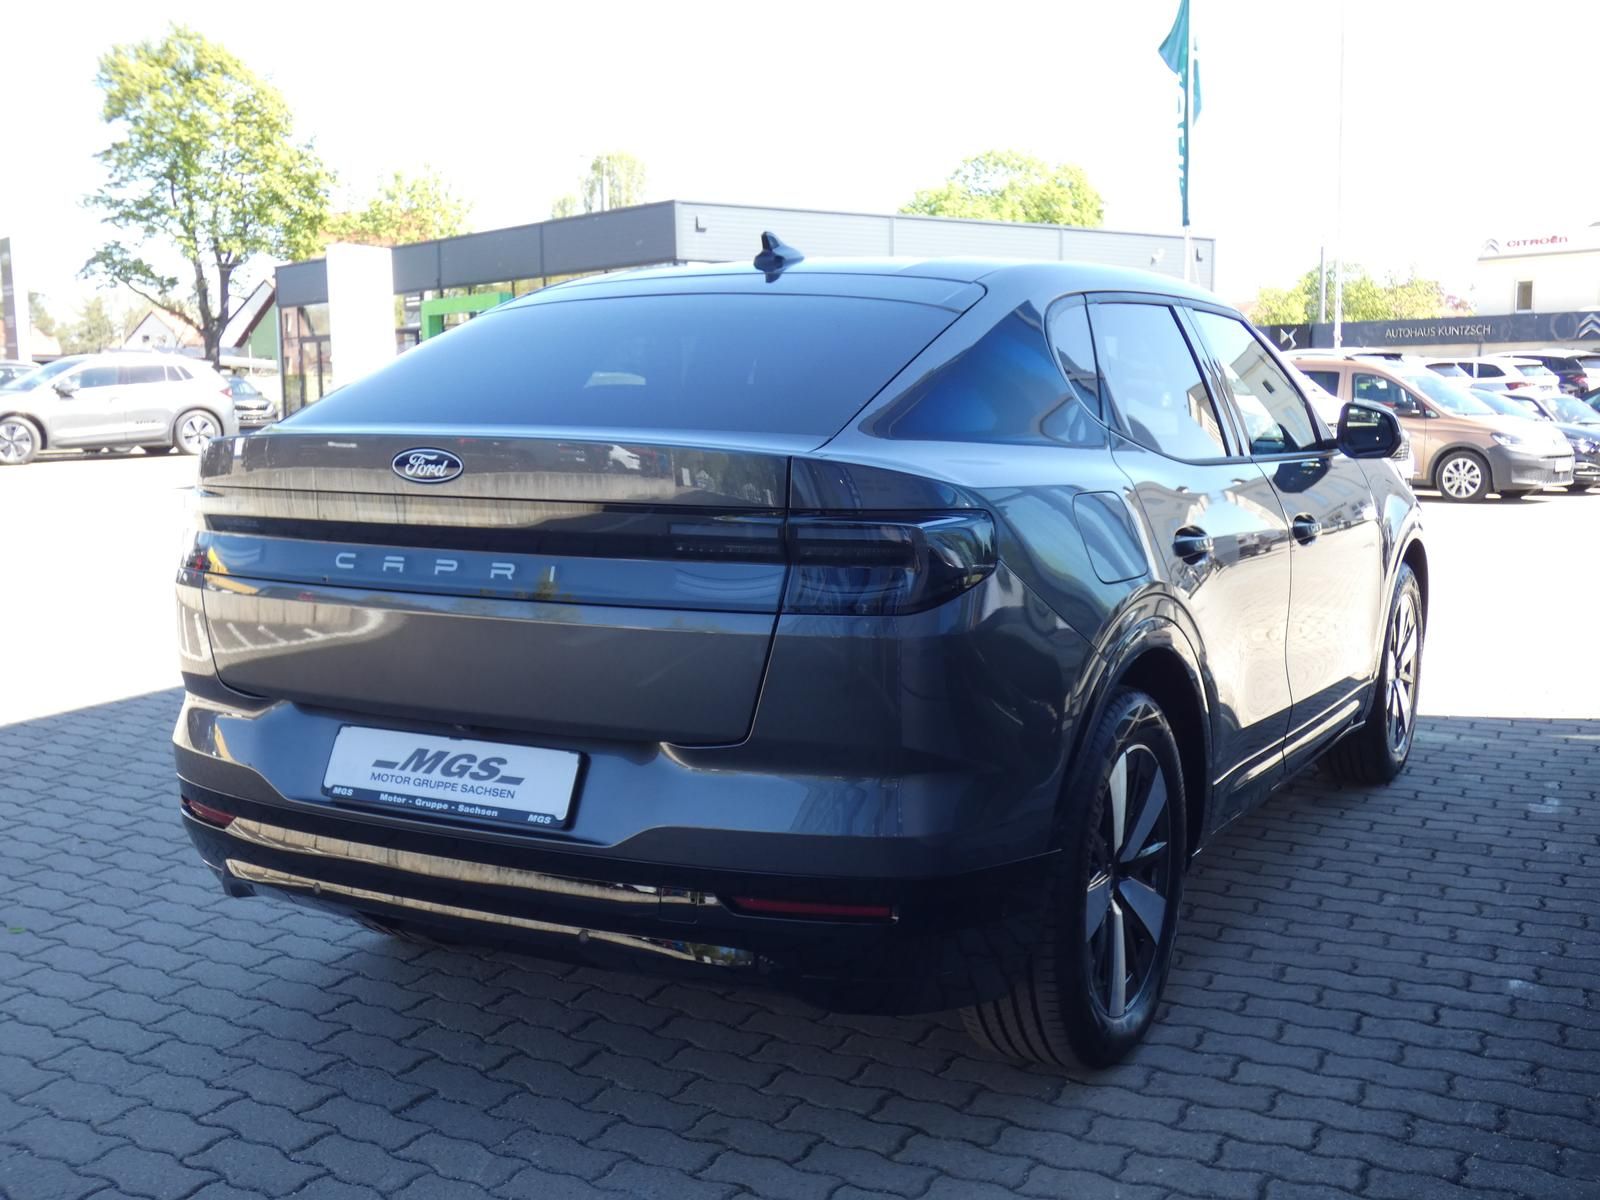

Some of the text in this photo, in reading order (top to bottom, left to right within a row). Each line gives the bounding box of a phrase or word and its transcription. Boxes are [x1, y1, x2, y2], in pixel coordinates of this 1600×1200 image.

[1385, 324, 1491, 339] AUTOHAUS KUNTZSCH
[405, 453, 448, 477] Ford
[335, 552, 556, 583] CAPRI
[397, 748, 508, 781] MGS
[332, 786, 353, 797] MGS
[370, 771, 516, 800] MOTOR GRUPPE SACHSEN
[379, 793, 406, 804] Motor
[415, 798, 448, 811] Gruppe
[457, 804, 498, 817] Sachsen
[527, 814, 551, 825] MGS
